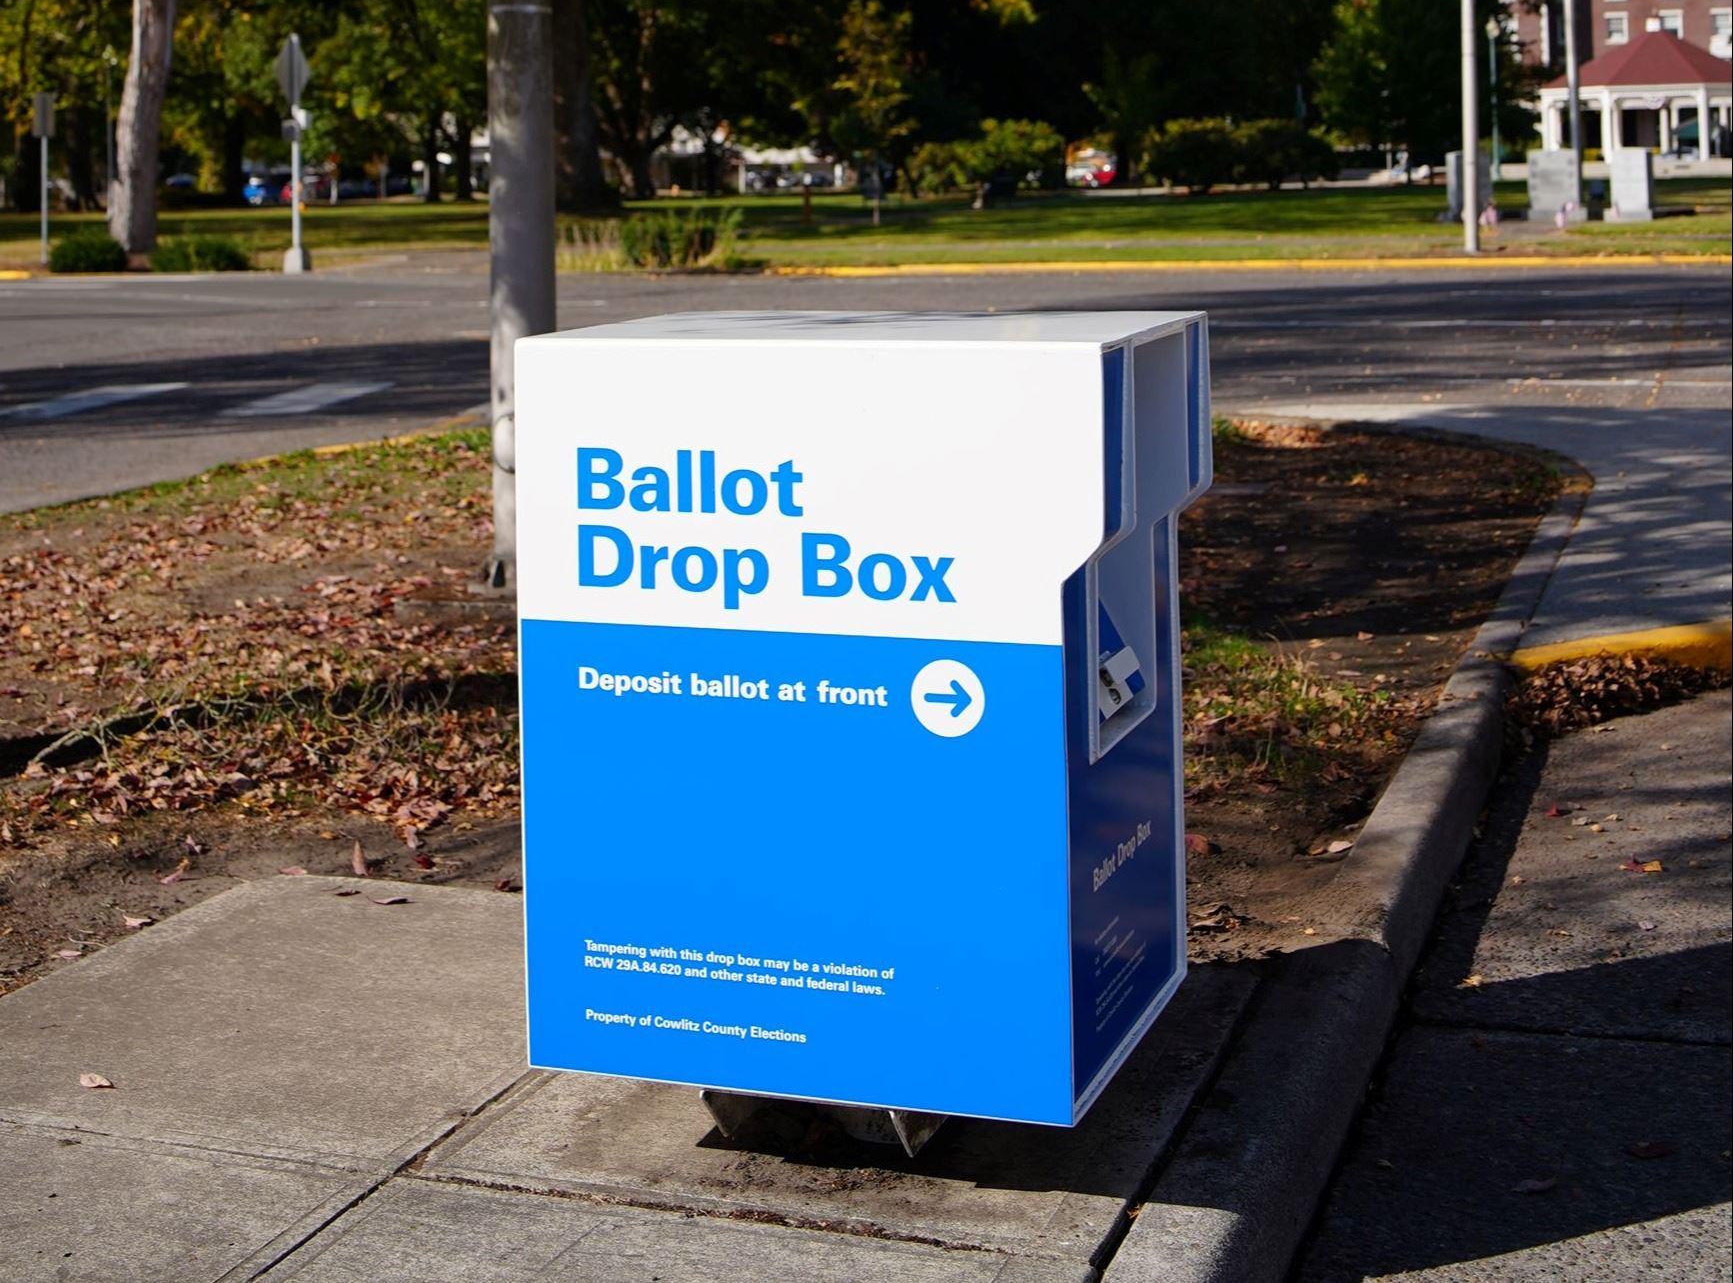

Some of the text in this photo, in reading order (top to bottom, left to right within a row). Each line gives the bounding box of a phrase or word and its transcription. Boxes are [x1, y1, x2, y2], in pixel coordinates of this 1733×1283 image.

[577, 447, 804, 517] Ballot
[577, 524, 957, 610] Drop Box
[578, 666, 888, 707] Deposit ballot at front
[1093, 820, 1152, 893] Ballot Drop Box
[584, 939, 895, 980] Tampering with this drop box may be a violation of
[584, 955, 886, 996] RCW 29A.84.620 and other state and federal laws.
[585, 1008, 807, 1044] Property of Cowlitz County Elections
